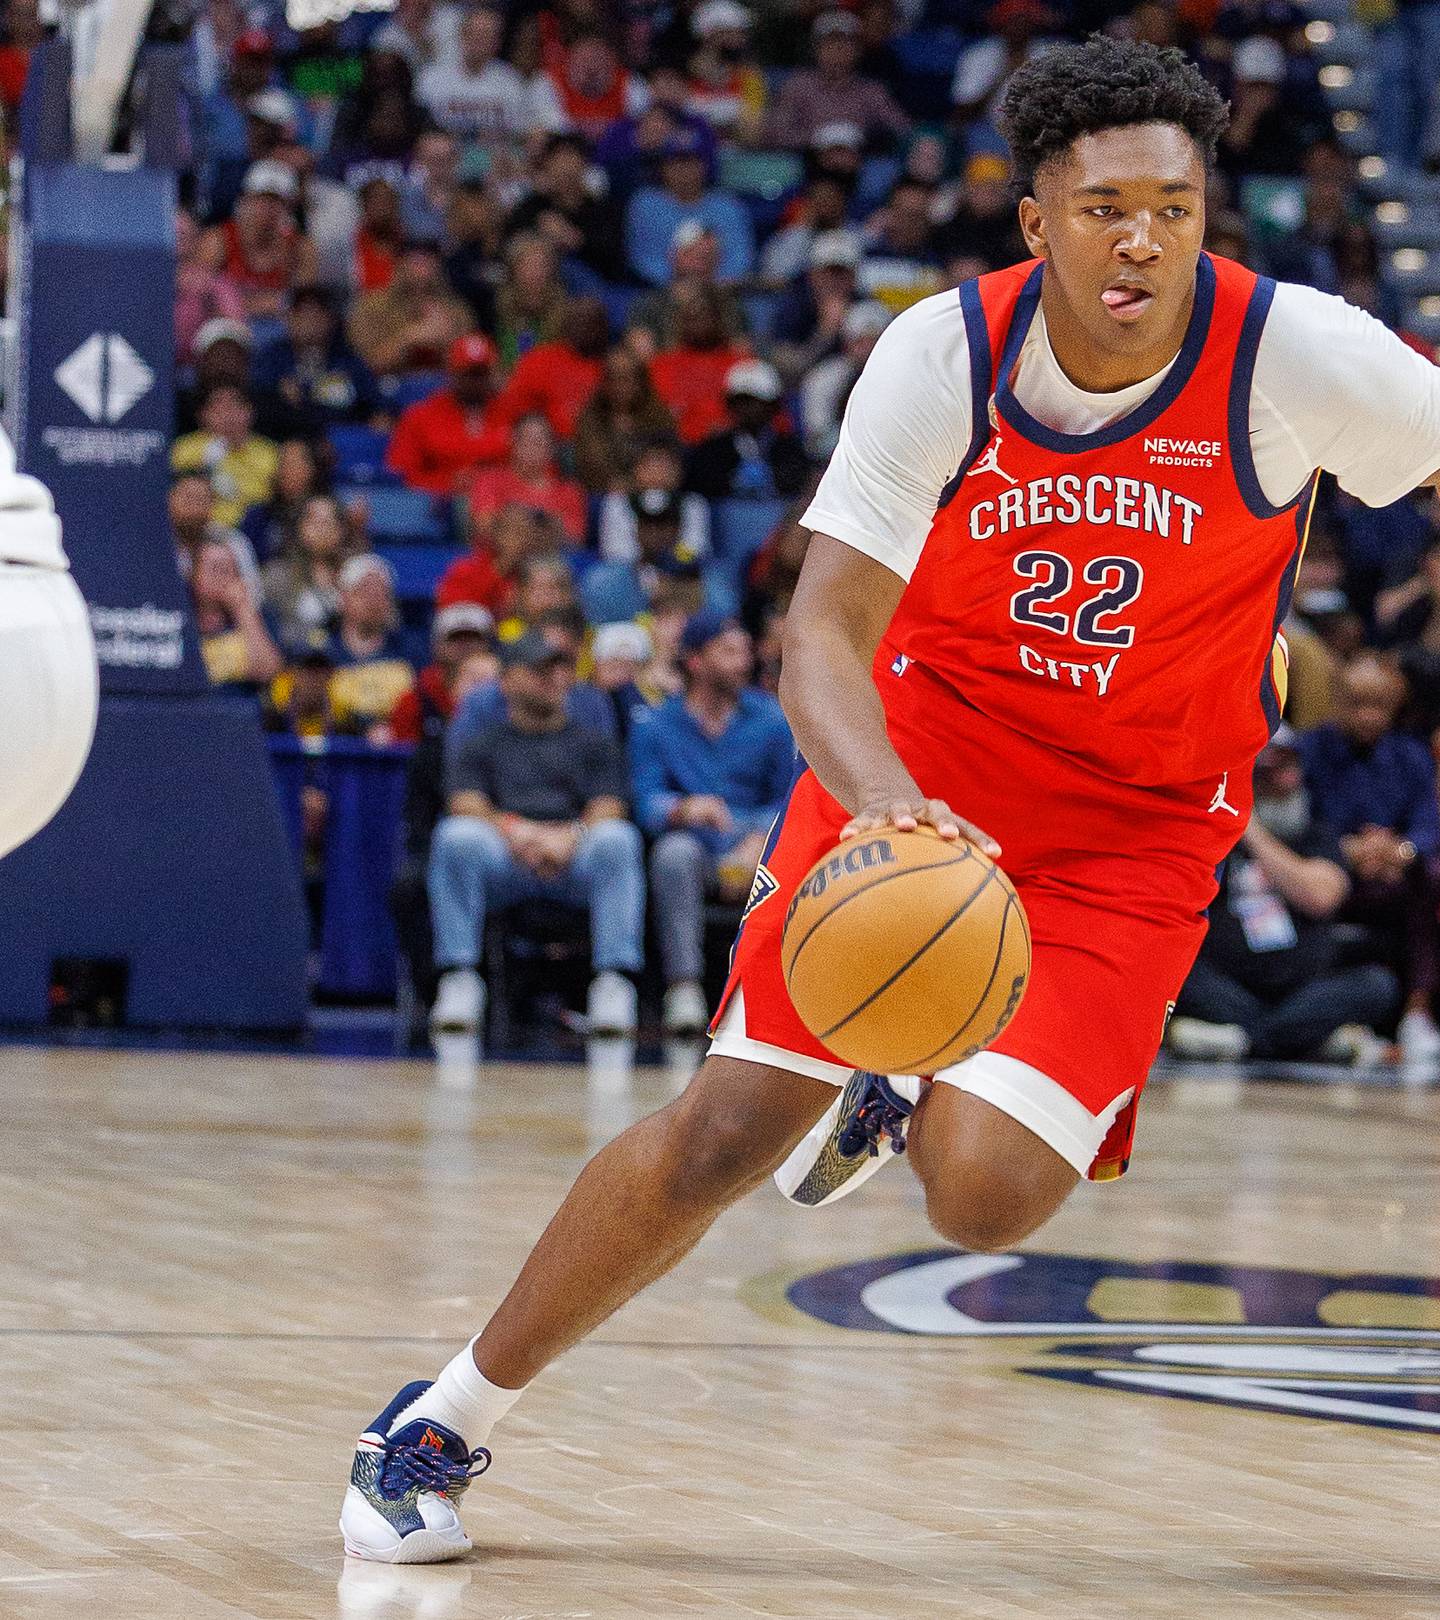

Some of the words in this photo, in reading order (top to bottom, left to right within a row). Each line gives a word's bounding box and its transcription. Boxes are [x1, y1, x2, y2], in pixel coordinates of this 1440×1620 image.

[1143, 437, 1222, 457] NEWAGE
[1149, 455, 1213, 468] PRODUCTS
[968, 473, 1203, 545] CRESCENT
[1009, 549, 1144, 649] 22
[1018, 644, 1121, 697] CITY
